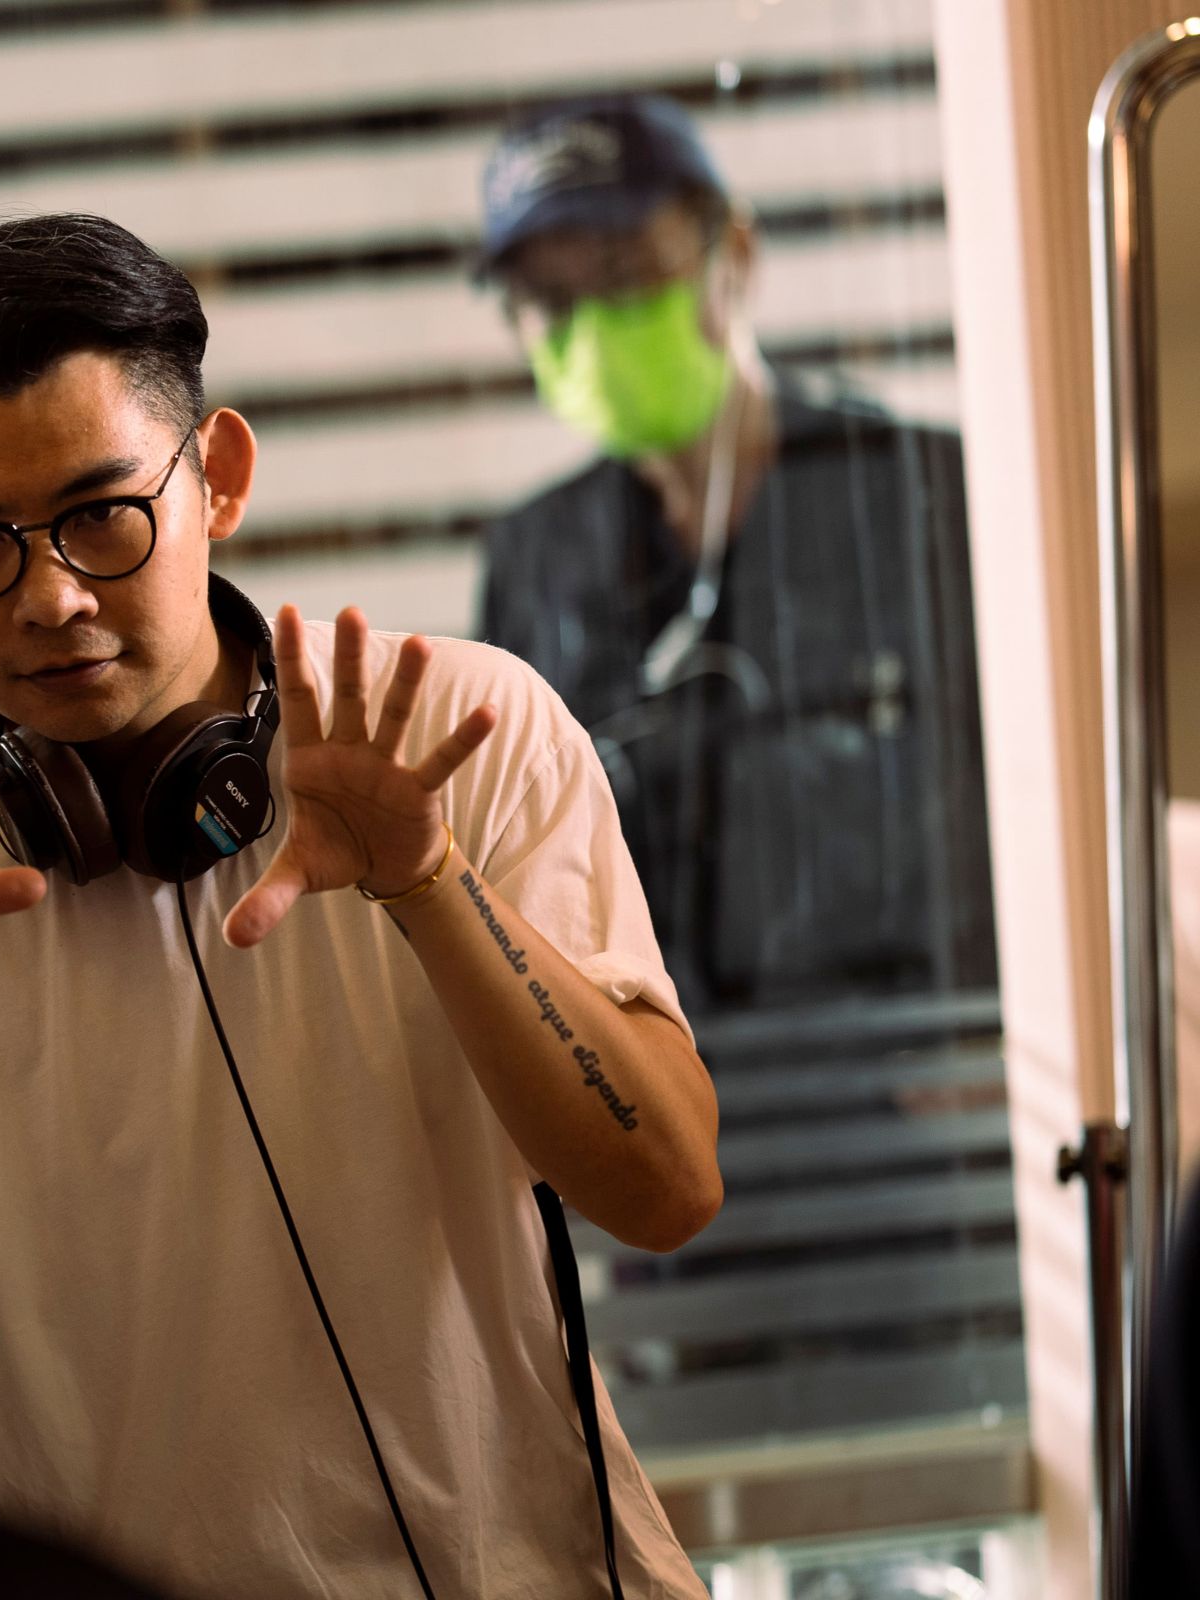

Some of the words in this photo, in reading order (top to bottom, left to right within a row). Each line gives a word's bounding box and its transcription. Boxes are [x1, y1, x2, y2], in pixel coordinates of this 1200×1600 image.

[225, 780, 250, 808] SONY
[458, 869, 528, 975] miserando
[528, 980, 574, 1042] atque
[572, 1045, 638, 1131] eligendo
